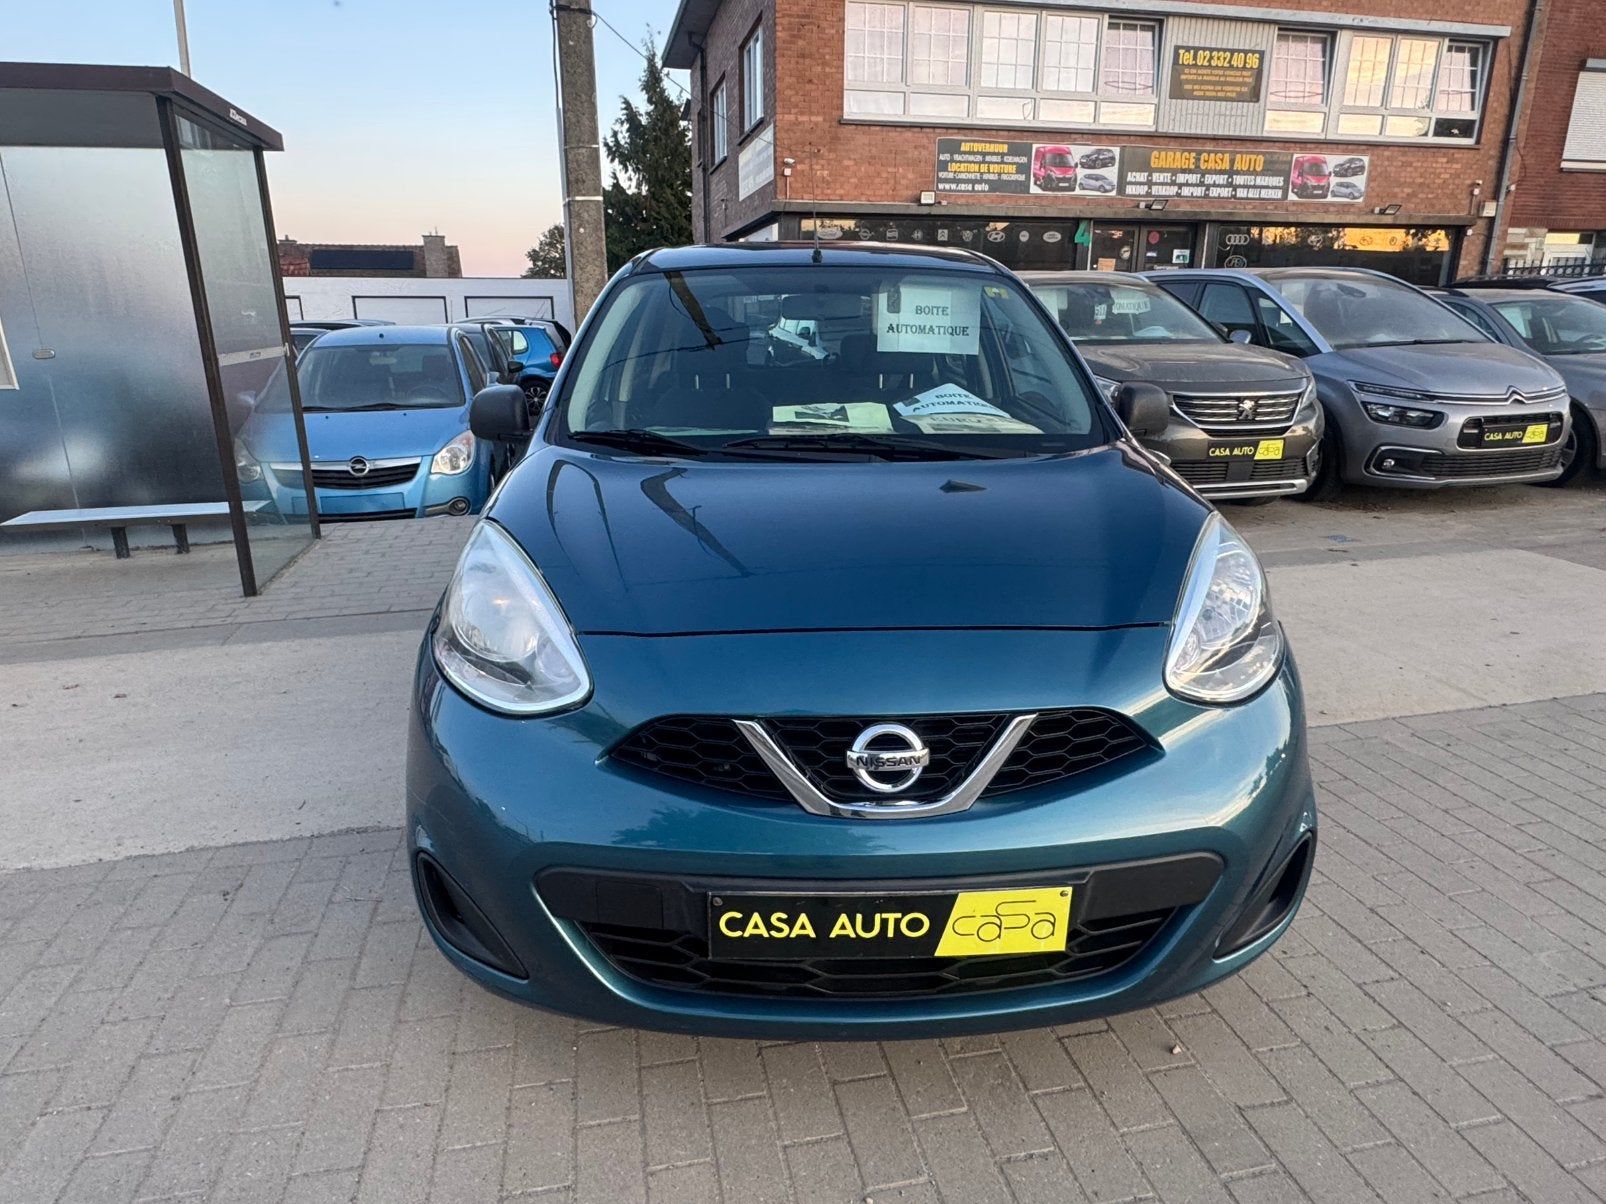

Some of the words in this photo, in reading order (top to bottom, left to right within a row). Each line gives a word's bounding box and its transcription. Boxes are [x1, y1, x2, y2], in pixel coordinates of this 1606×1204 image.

[1178, 49, 1196, 65] Tel.
[1197, 50, 1210, 66] 02
[1211, 51, 1230, 67] 332
[1231, 52, 1244, 68] 40
[1246, 53, 1260, 69] 96
[1151, 150, 1196, 169] GARAGE
[1200, 152, 1230, 170] CASA
[1233, 154, 1264, 171] AUTO
[948, 162, 979, 172] LOCATION
[980, 163, 988, 173] DE
[989, 164, 1017, 174] VOITURE
[1127, 171, 1148, 182] ACHAT
[1152, 172, 1172, 183] VENTE
[1176, 173, 1201, 184] IMPORT
[1204, 174, 1229, 185] EXPORT
[1232, 175, 1255, 186] TOUTES
[1255, 176, 1284, 187] MARQUES
[1125, 185, 1149, 195] INKOOP
[1151, 185, 1179, 196] VERKOOP
[1181, 186, 1207, 197] IMPORT
[1209, 187, 1233, 198] EXPORT
[1236, 188, 1248, 198] VAN
[915, 305, 949, 316] BOITE
[886, 323, 970, 337] AUTOMATIQUE
[912, 400, 998, 412] AUTOMATIQ
[1484, 432, 1503, 441] CASA
[1503, 431, 1523, 440] AUTO
[1208, 447, 1230, 456] CASA
[1232, 446, 1254, 456] AUTO
[856, 755, 921, 767] NISSAN
[718, 911, 817, 939] CASA
[829, 911, 930, 939] AUTO
